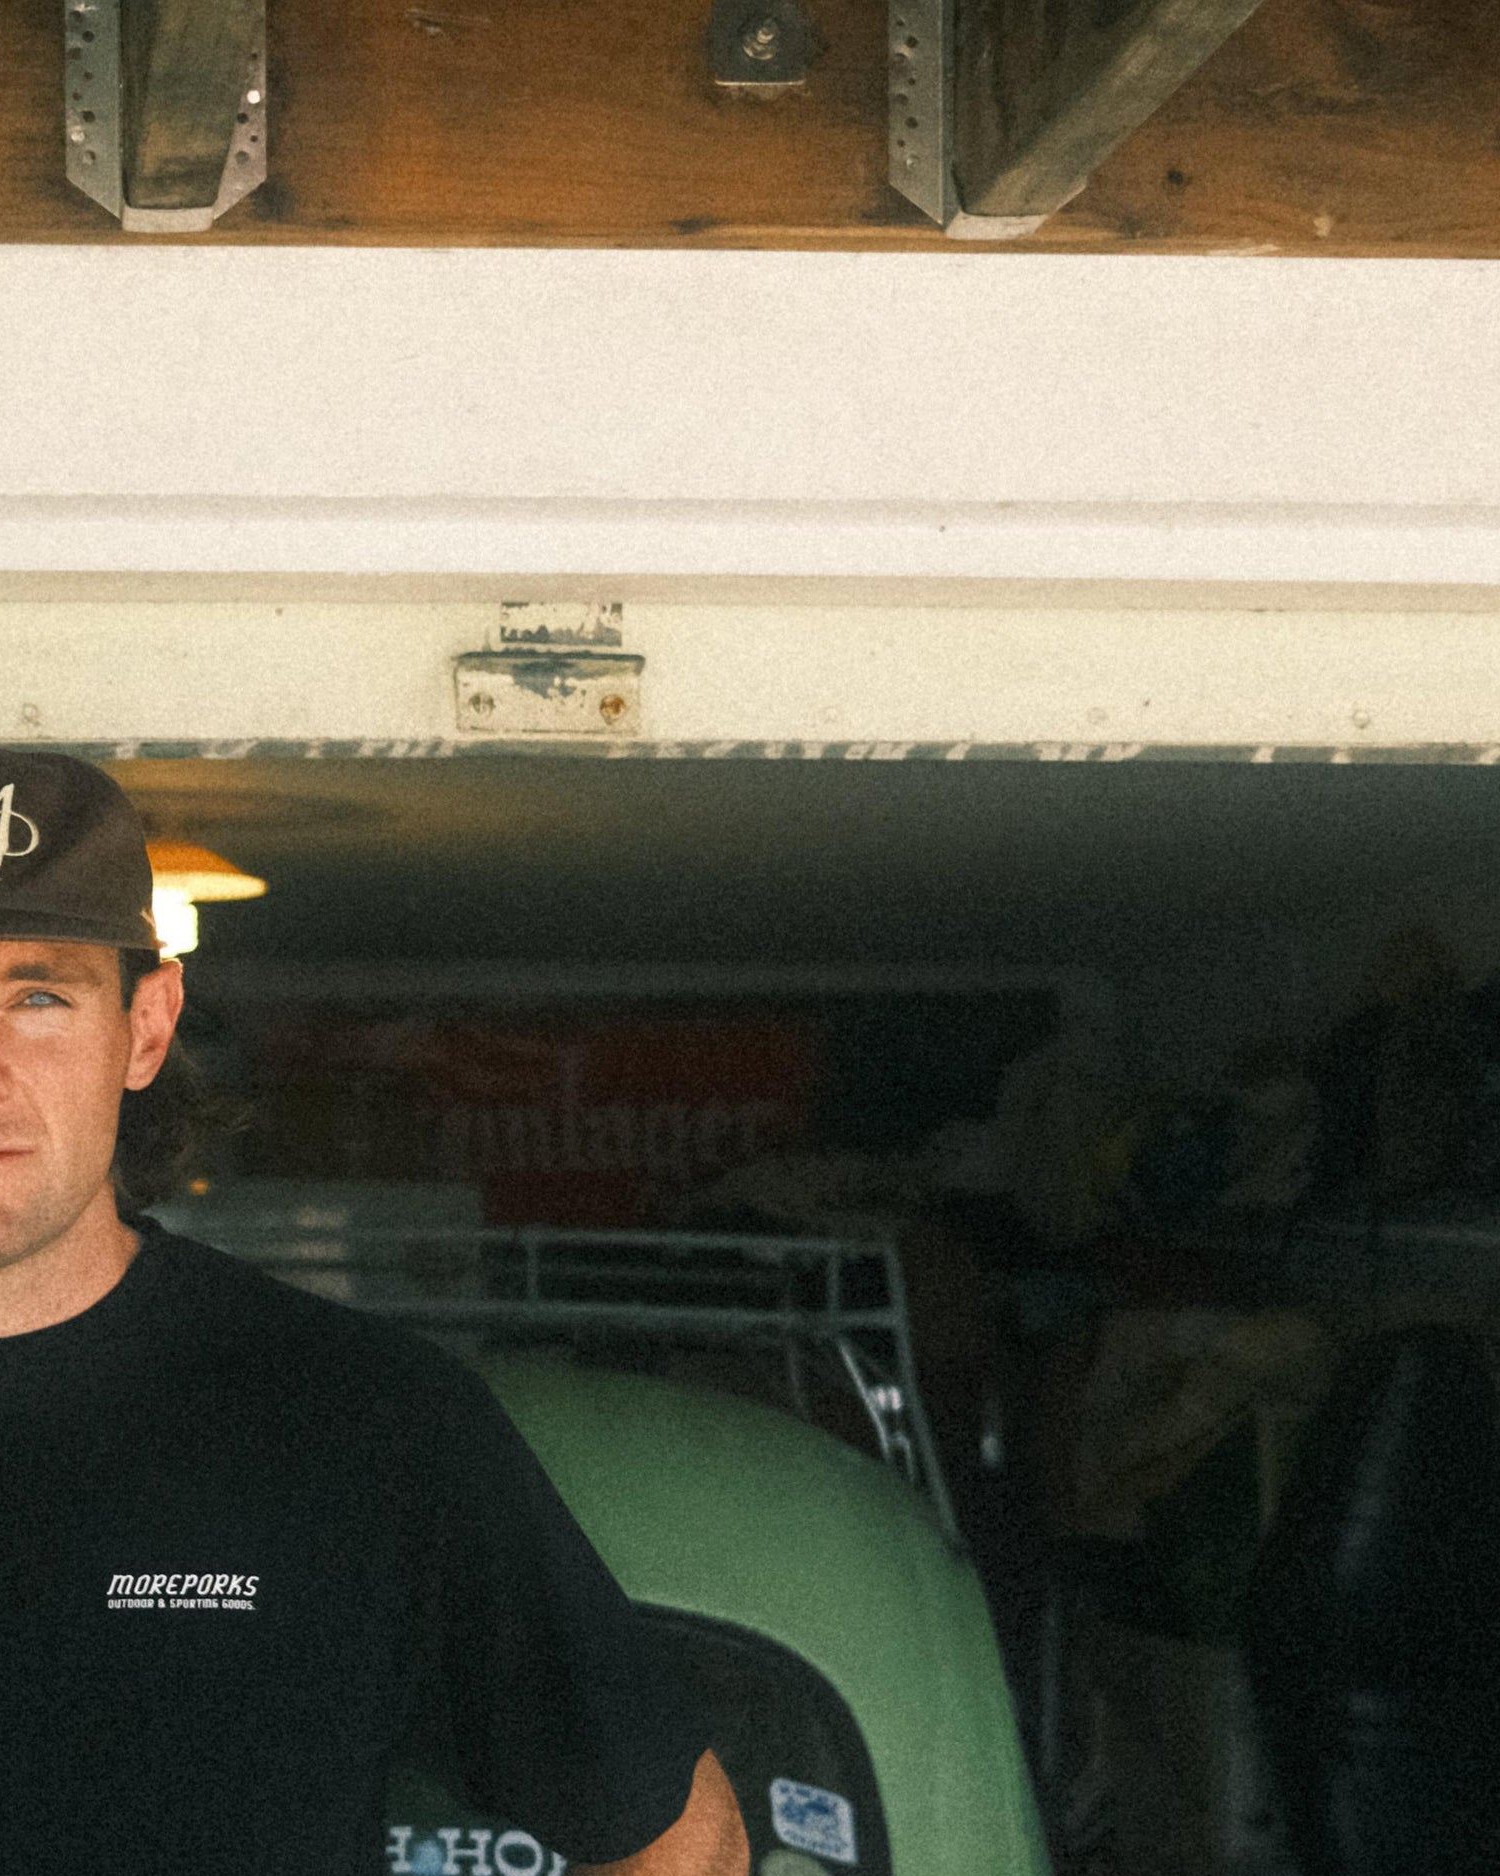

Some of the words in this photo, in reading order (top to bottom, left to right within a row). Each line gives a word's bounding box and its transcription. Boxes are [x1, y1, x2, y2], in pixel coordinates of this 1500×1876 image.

[106, 1573, 260, 1597] MOREPORKS
[107, 1598, 155, 1609] OUTDOOR
[157, 1598, 166, 1609] &
[169, 1598, 219, 1609] SPORTING
